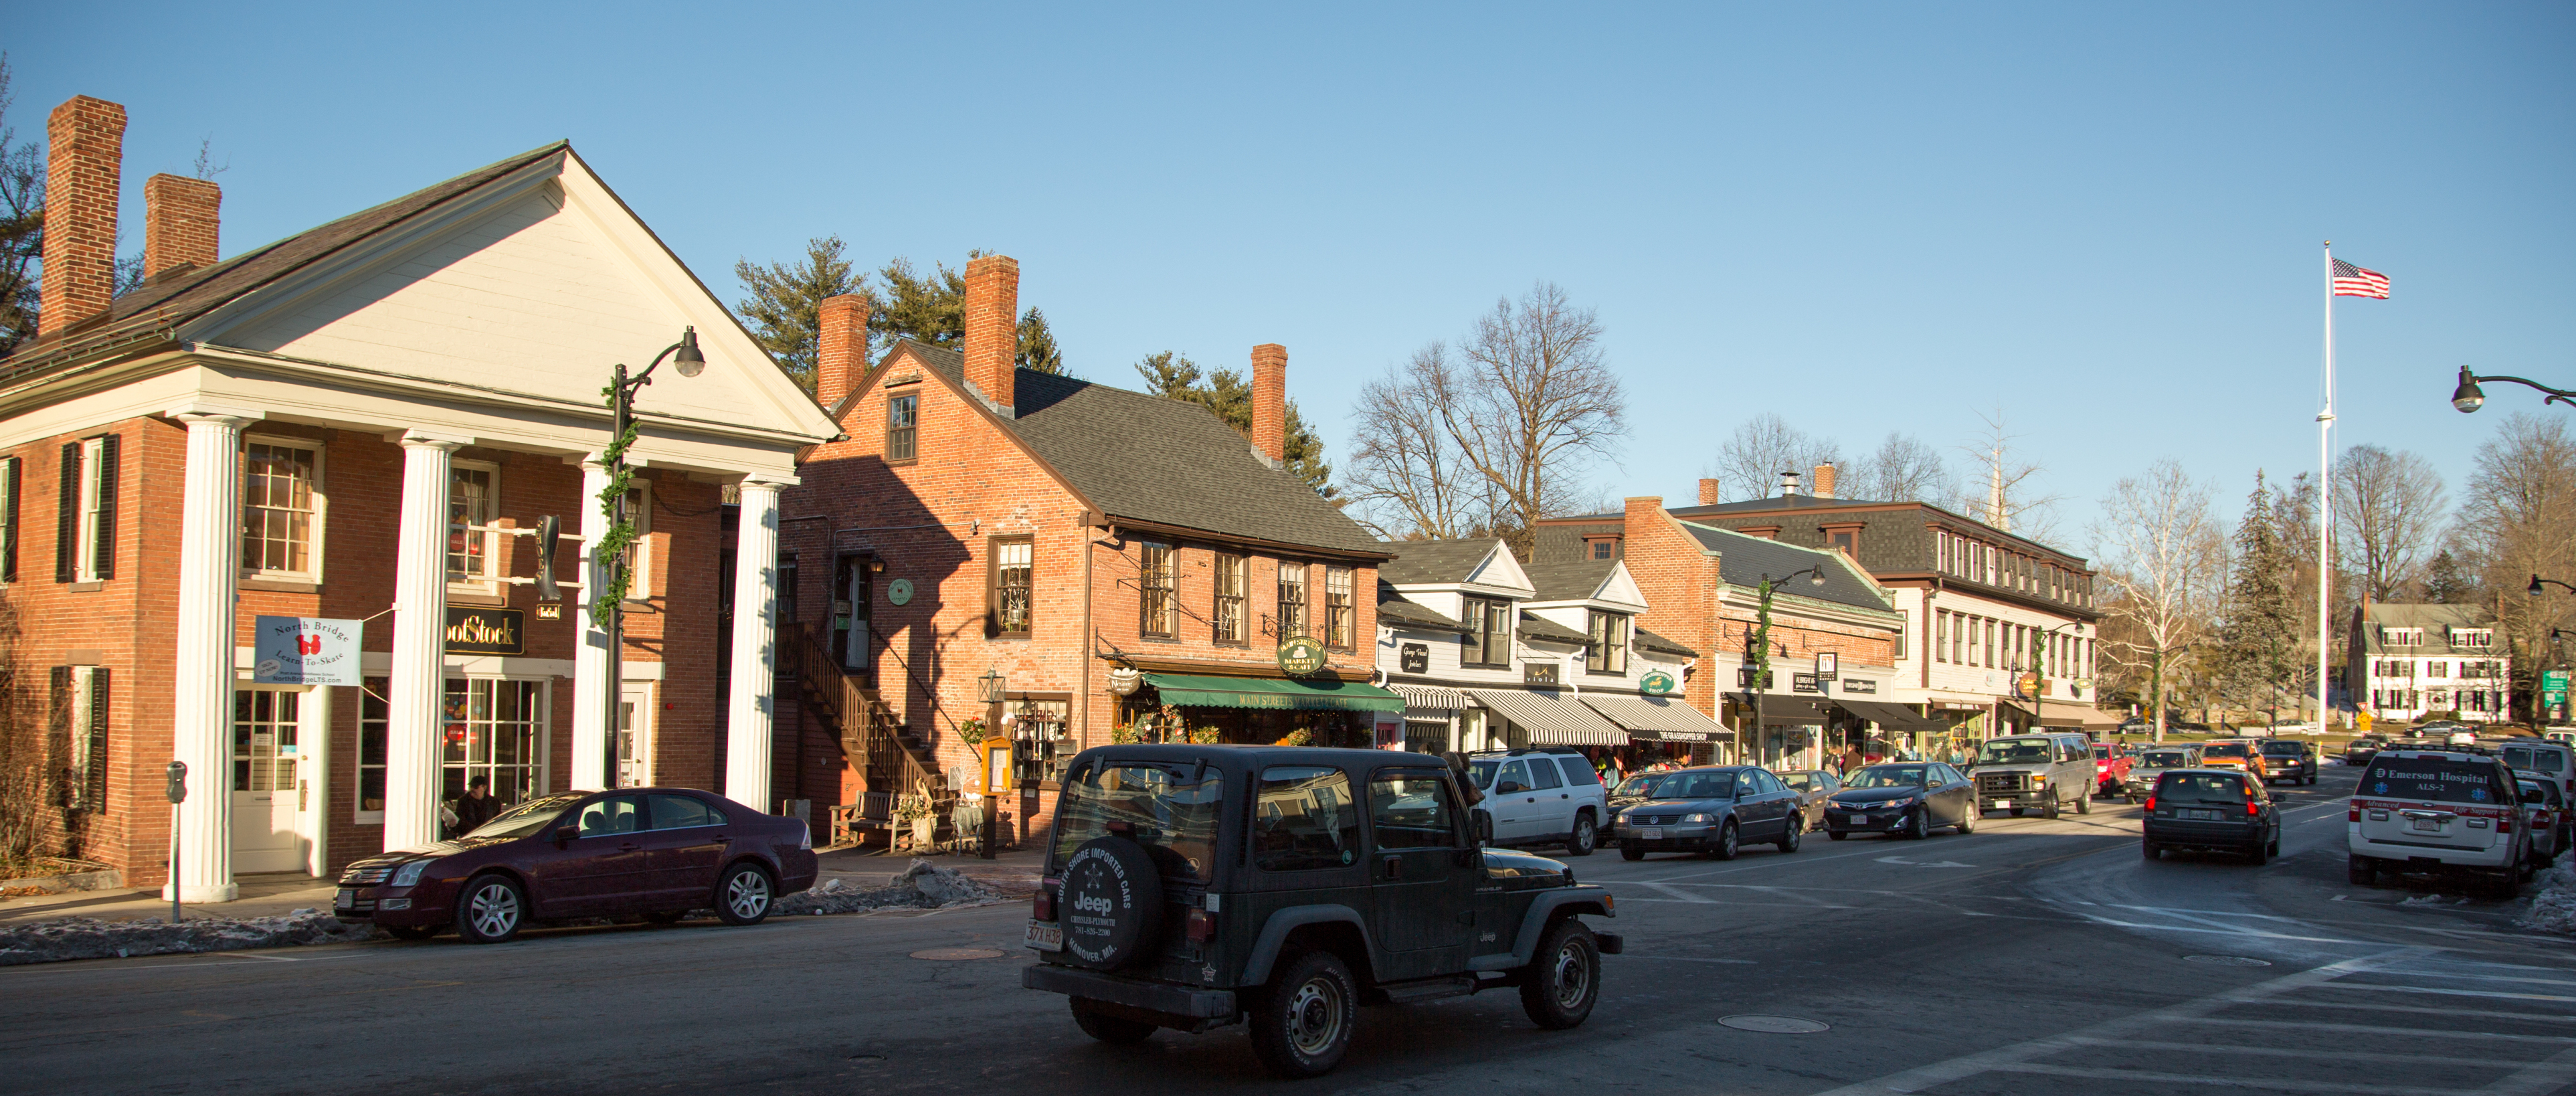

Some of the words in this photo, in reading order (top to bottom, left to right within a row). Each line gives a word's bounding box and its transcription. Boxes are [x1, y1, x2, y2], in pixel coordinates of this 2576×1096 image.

[535, 520, 544, 581] SHOES
[274, 621, 308, 636] North
[314, 622, 349, 642] Bridge
[444, 615, 515, 645] ootStock
[1280, 640, 1296, 653] MAIN
[275, 650, 344, 666] Learn-To-Skate
[1641, 672, 1673, 682] GRASSHOPPER
[1796, 676, 1811, 684] ALBRIGHT
[1239, 694, 1259, 705] MAIN
[1261, 695, 1293, 707] STREETS
[1295, 697, 1324, 707] MARKET
[1330, 698, 1348, 708] CAFE
[1668, 732, 1696, 740] GRASSHOPPER
[2389, 769, 2435, 780] Emerson
[2440, 771, 2488, 784] Hospital
[2365, 800, 2400, 808] Advanced
[2470, 807, 2498, 816] Support
[1058, 869, 1070, 903] SOUTH
[1069, 848, 1089, 871] SHORE
[1091, 848, 1125, 879] IMPORTED
[1120, 880, 1131, 909] CARS
[1074, 891, 1112, 917] Jeep
[1071, 915, 1115, 927] CHRYSLER-PLYMOUTH
[1026, 925, 1044, 942] 37X
[1044, 927, 1061, 944] H38
[1075, 926, 1111, 937] 781-826-2200
[1480, 933, 1496, 943] Jeep
[1069, 937, 1103, 962] HANOVER,
[1102, 945, 1117, 959] MA.
[1325, 967, 1353, 1019] All-Terrain
